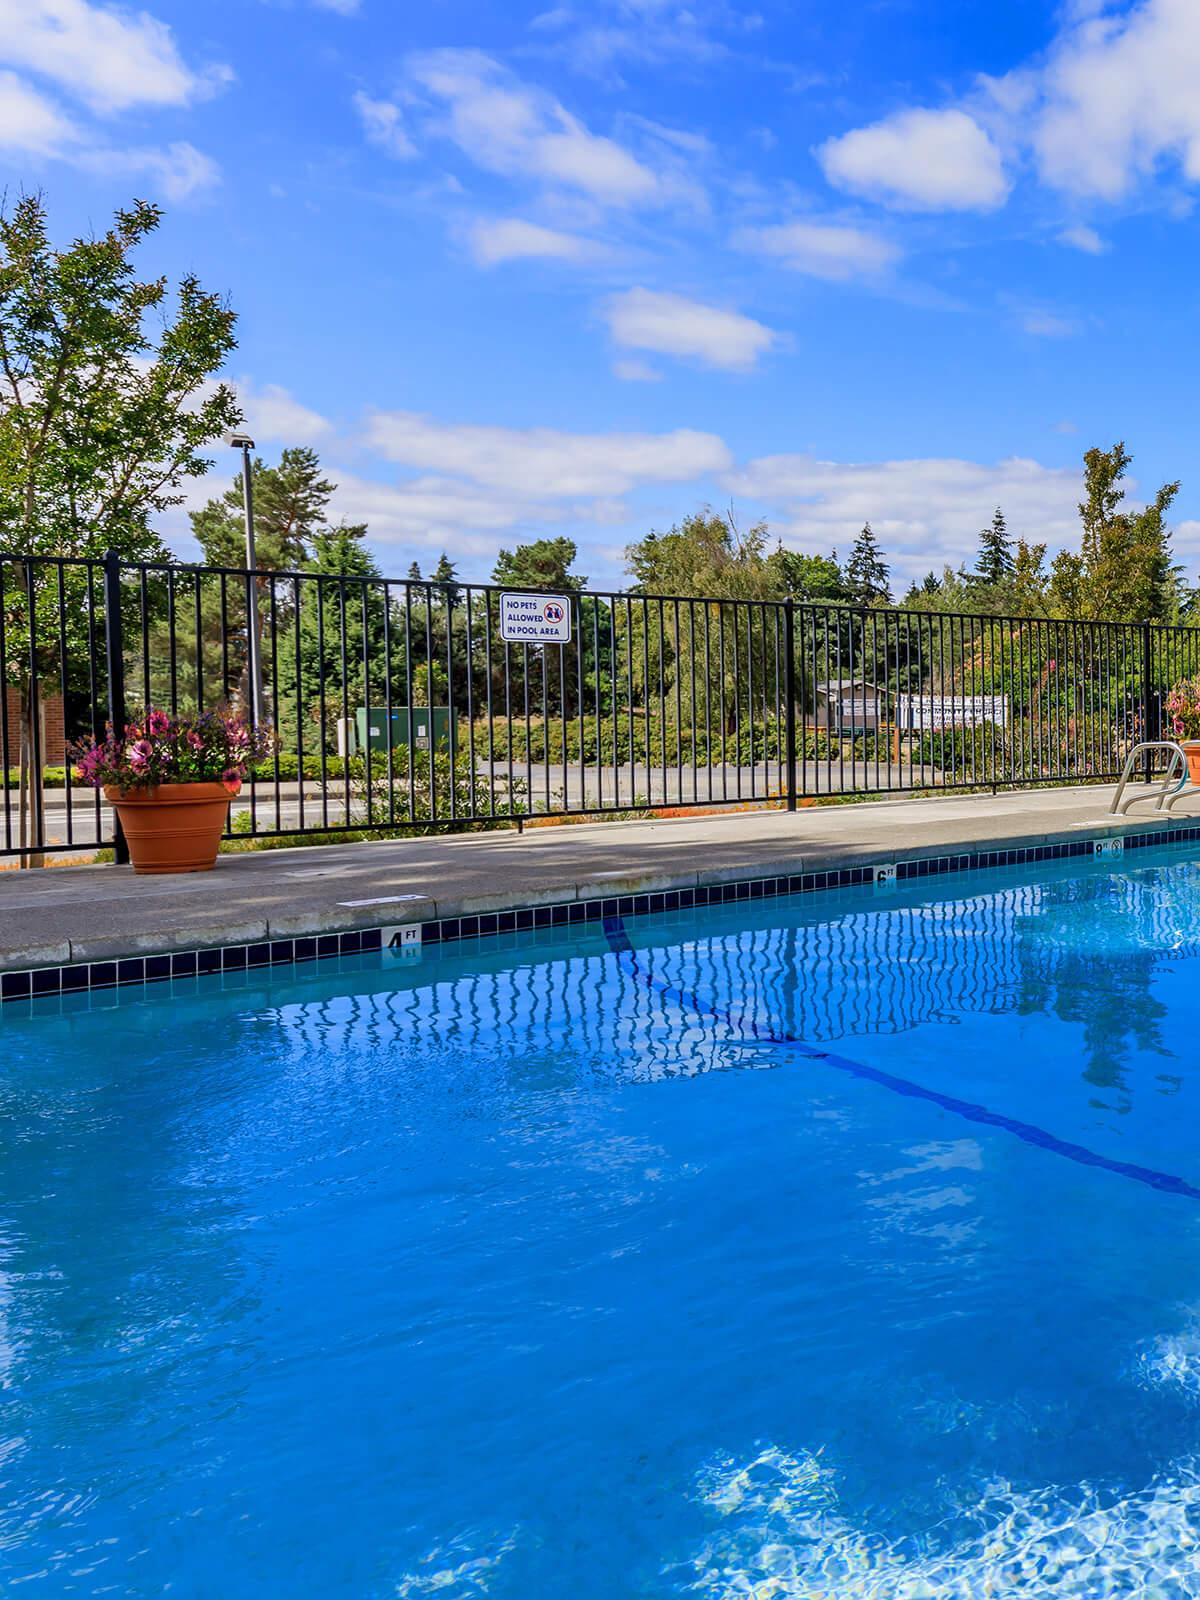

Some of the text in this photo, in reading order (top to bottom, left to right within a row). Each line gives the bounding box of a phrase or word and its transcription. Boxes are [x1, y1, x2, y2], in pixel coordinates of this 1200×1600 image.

[508, 614, 544, 622] ALLOWED
[878, 870, 886, 882] 6
[388, 930, 416, 948] 4 FT
